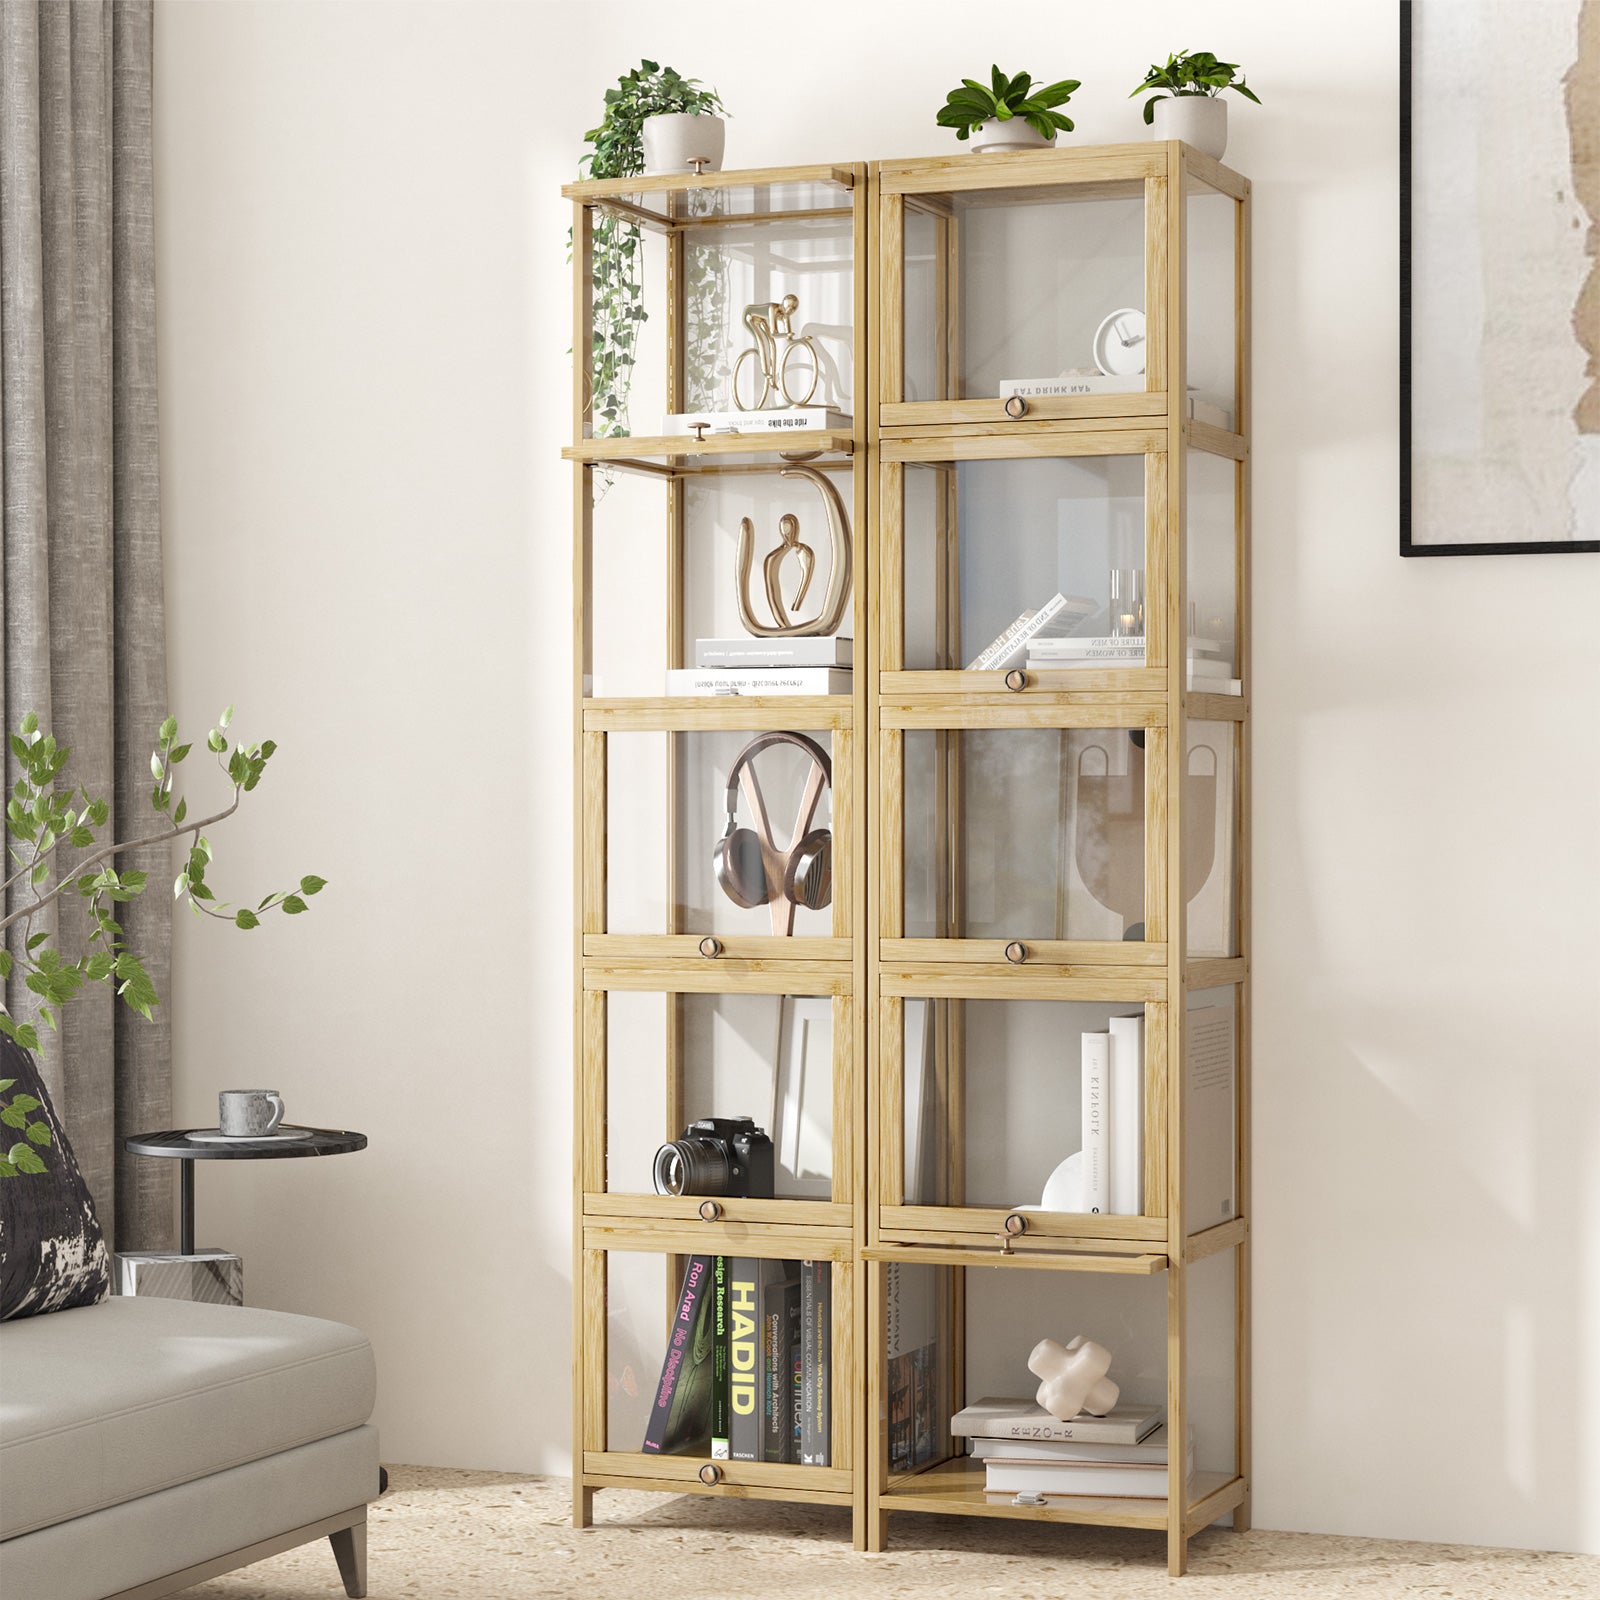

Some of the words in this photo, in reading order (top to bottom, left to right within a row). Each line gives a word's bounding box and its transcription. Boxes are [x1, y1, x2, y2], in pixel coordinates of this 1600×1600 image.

[767, 418, 782, 428] bike
[783, 418, 794, 428] the
[794, 418, 808, 428] ride
[688, 1261, 703, 1289] Ron
[679, 1289, 696, 1322] Arad
[716, 1286, 725, 1336] Research
[671, 1327, 687, 1348] No
[731, 1281, 755, 1416] HADID
[772, 1314, 780, 1371] Conversations
[657, 1348, 682, 1408] Discipline
[772, 1392, 780, 1433] Architects
[1011, 1426, 1073, 1439] RENOIR
[732, 1451, 755, 1459] TASCHEN
